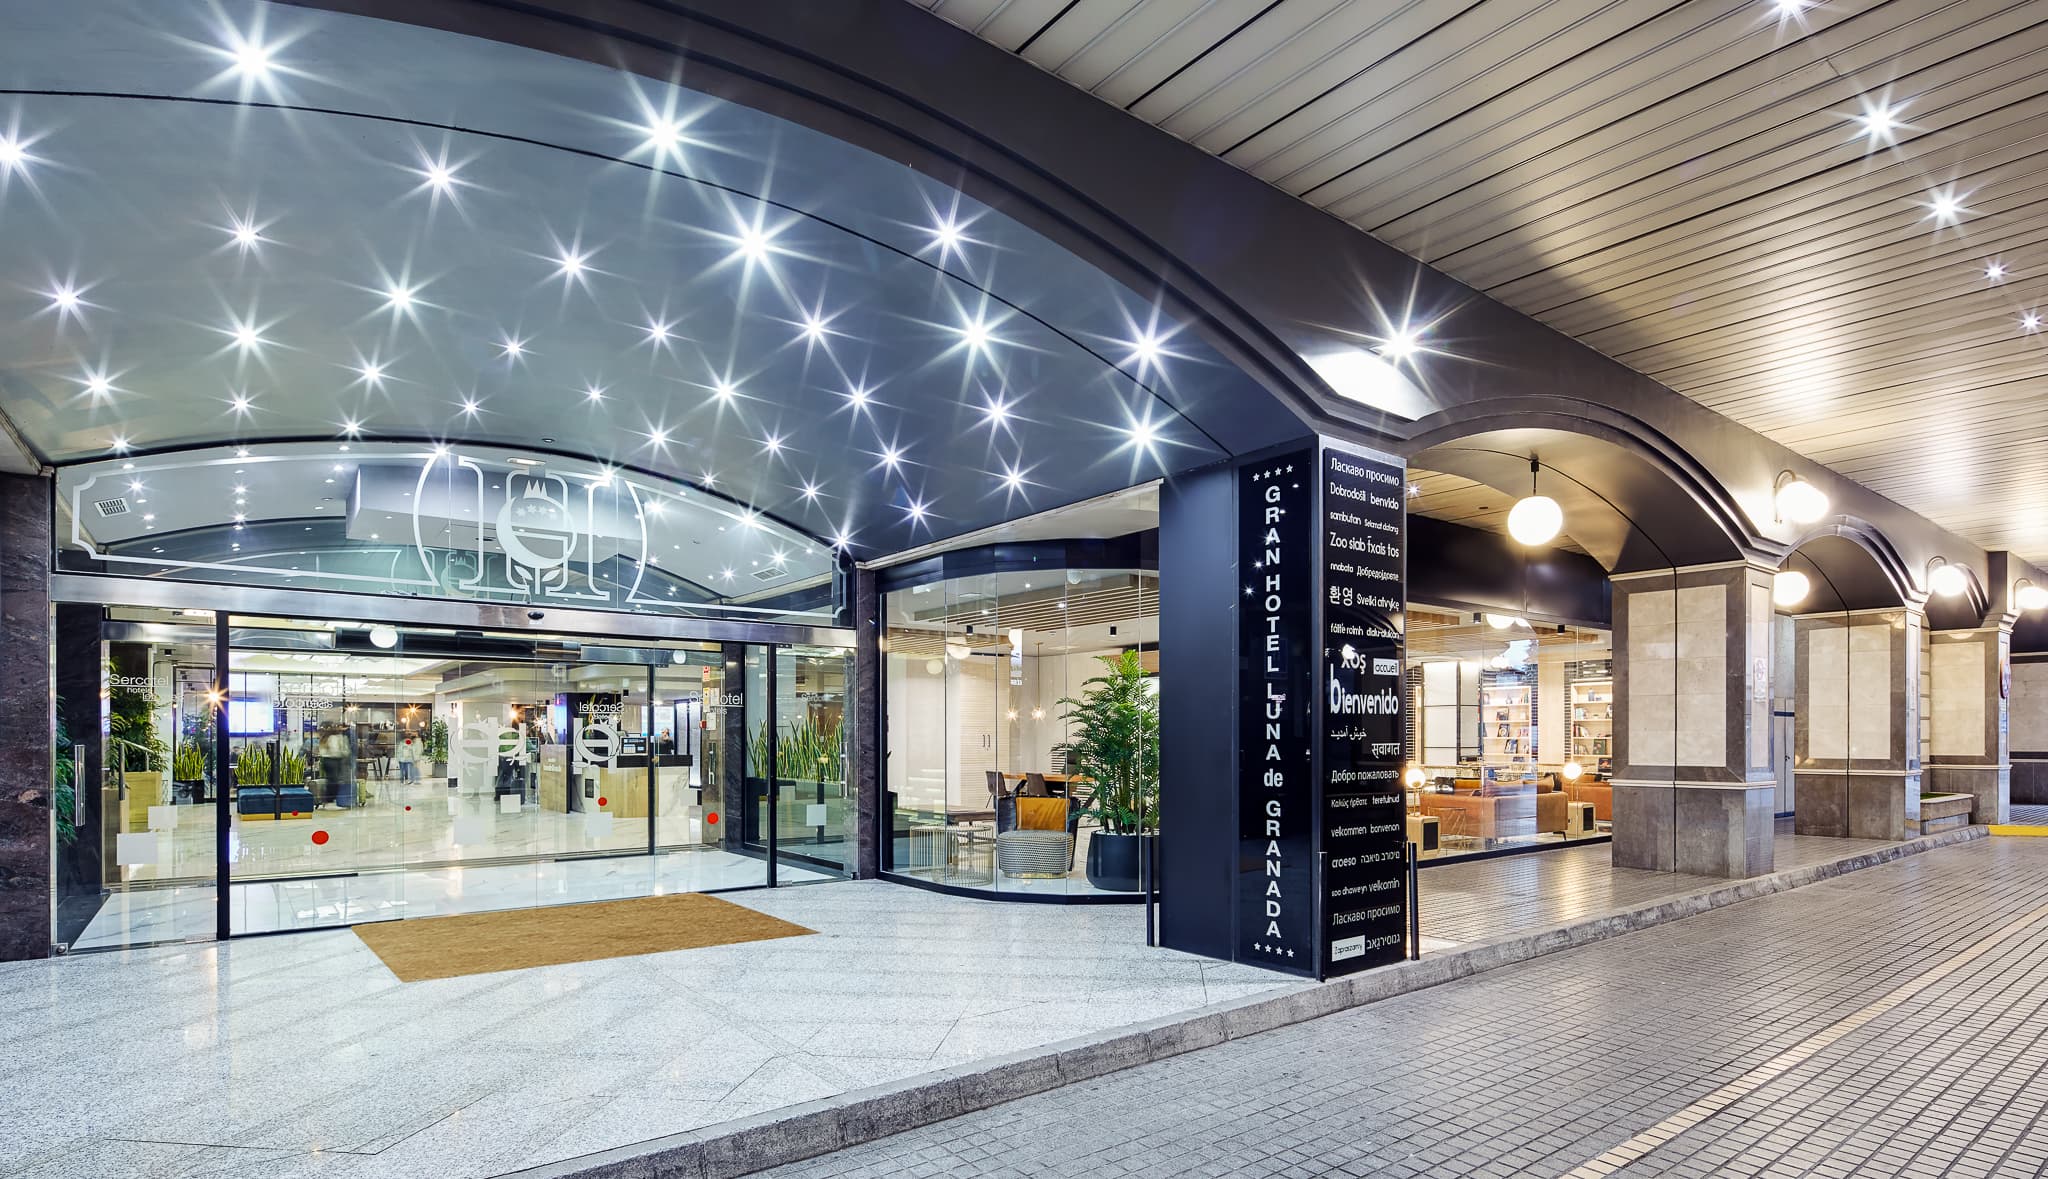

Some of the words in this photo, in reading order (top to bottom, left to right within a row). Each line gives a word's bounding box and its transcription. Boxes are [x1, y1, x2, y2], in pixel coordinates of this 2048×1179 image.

[1331, 457, 1364, 478] Ласкаво
[1366, 469, 1399, 486] просимо
[1370, 492, 1399, 510] benvido
[1265, 486, 1281, 566] GRAN
[1330, 531, 1348, 548] Zoo
[1349, 537, 1365, 551] siab
[1387, 543, 1399, 557] tos
[1329, 586, 1353, 606] 환영
[1265, 574, 1281, 673] HOTEL
[110, 673, 169, 685] Sercotel
[1330, 663, 1399, 715] bienvenido
[1266, 682, 1281, 761] LUNA
[1263, 768, 1283, 787] de
[1331, 769, 1356, 784] Добро
[1265, 800, 1281, 938] GRANADA
[1332, 911, 1365, 926] Ласкаво
[1367, 904, 1400, 920] просимо
